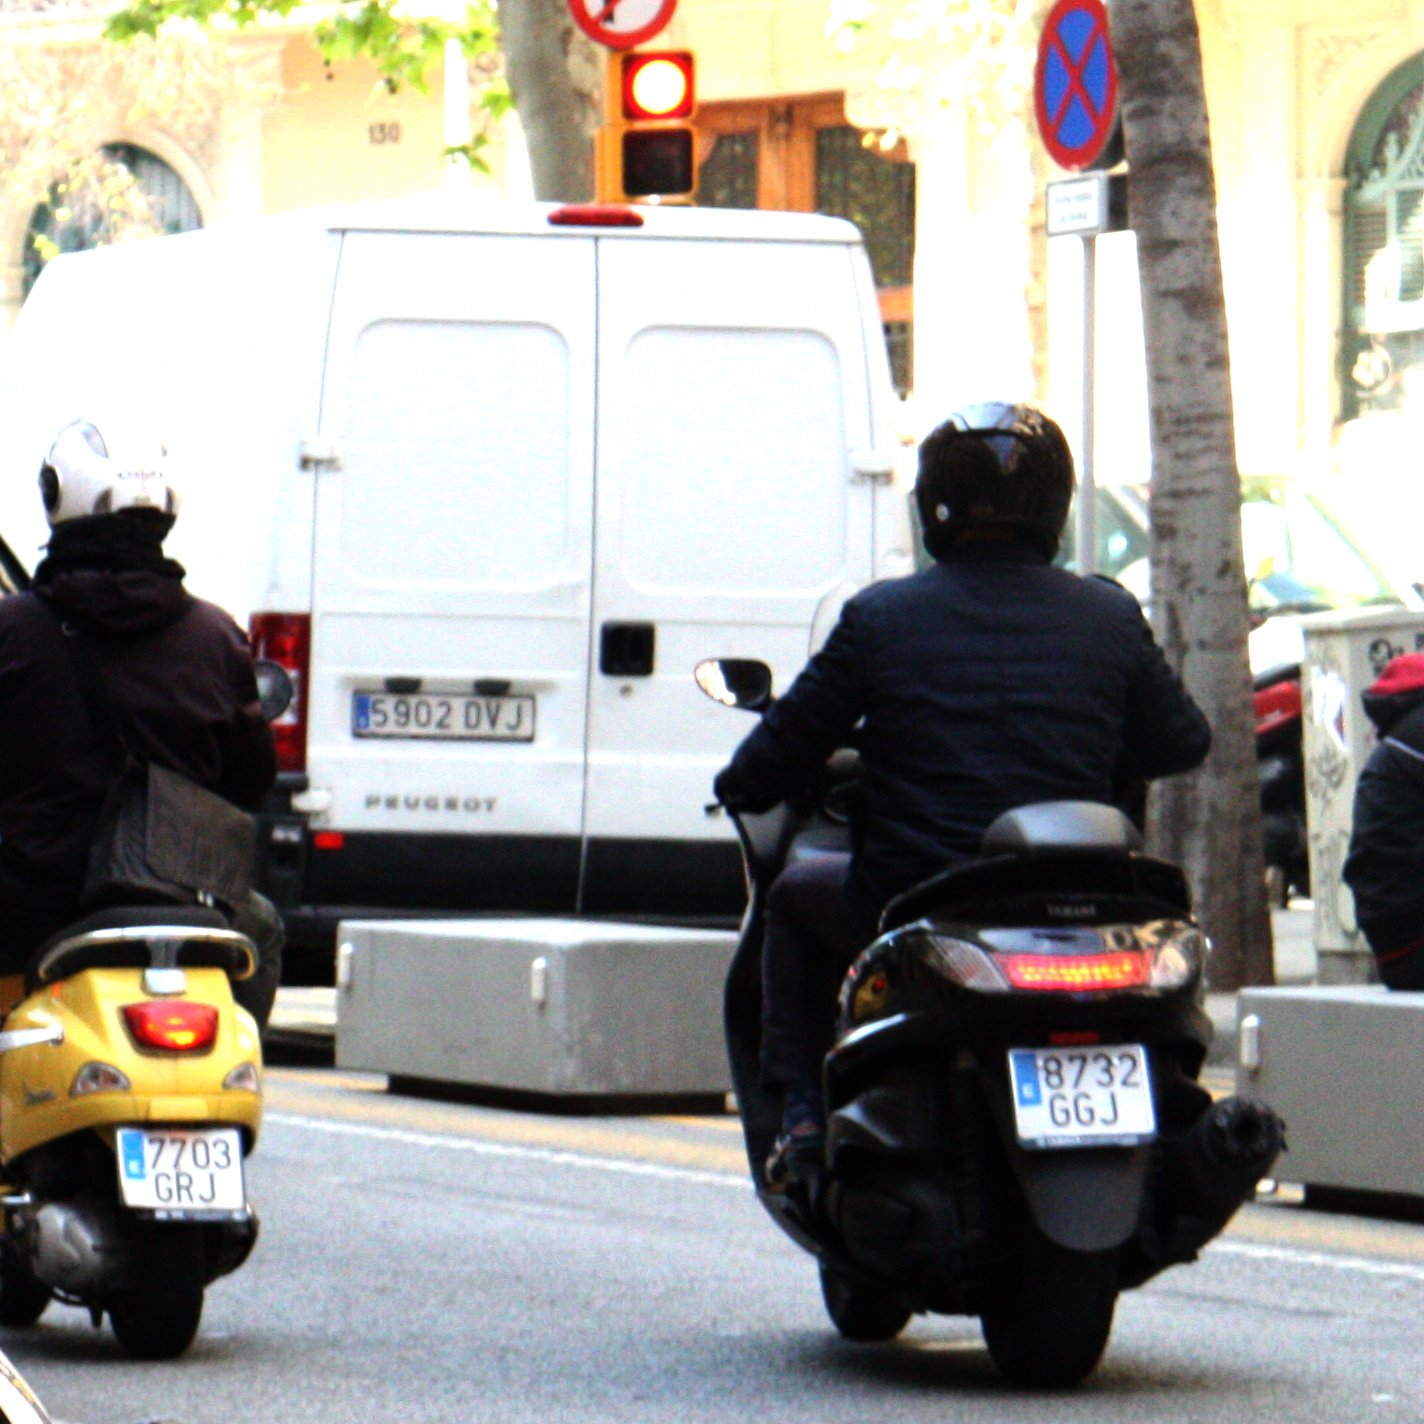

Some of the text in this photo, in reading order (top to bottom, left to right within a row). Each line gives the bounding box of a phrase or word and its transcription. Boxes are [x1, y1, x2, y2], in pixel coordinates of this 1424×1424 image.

[371, 698, 523, 732] 5902 DVJ
[364, 793, 498, 813] PEUGEOT
[1042, 1052, 1140, 1091] 8732
[1048, 1089, 1119, 1128] GGJ
[147, 1137, 232, 1170] 7703
[154, 1170, 217, 1204] GRJ
